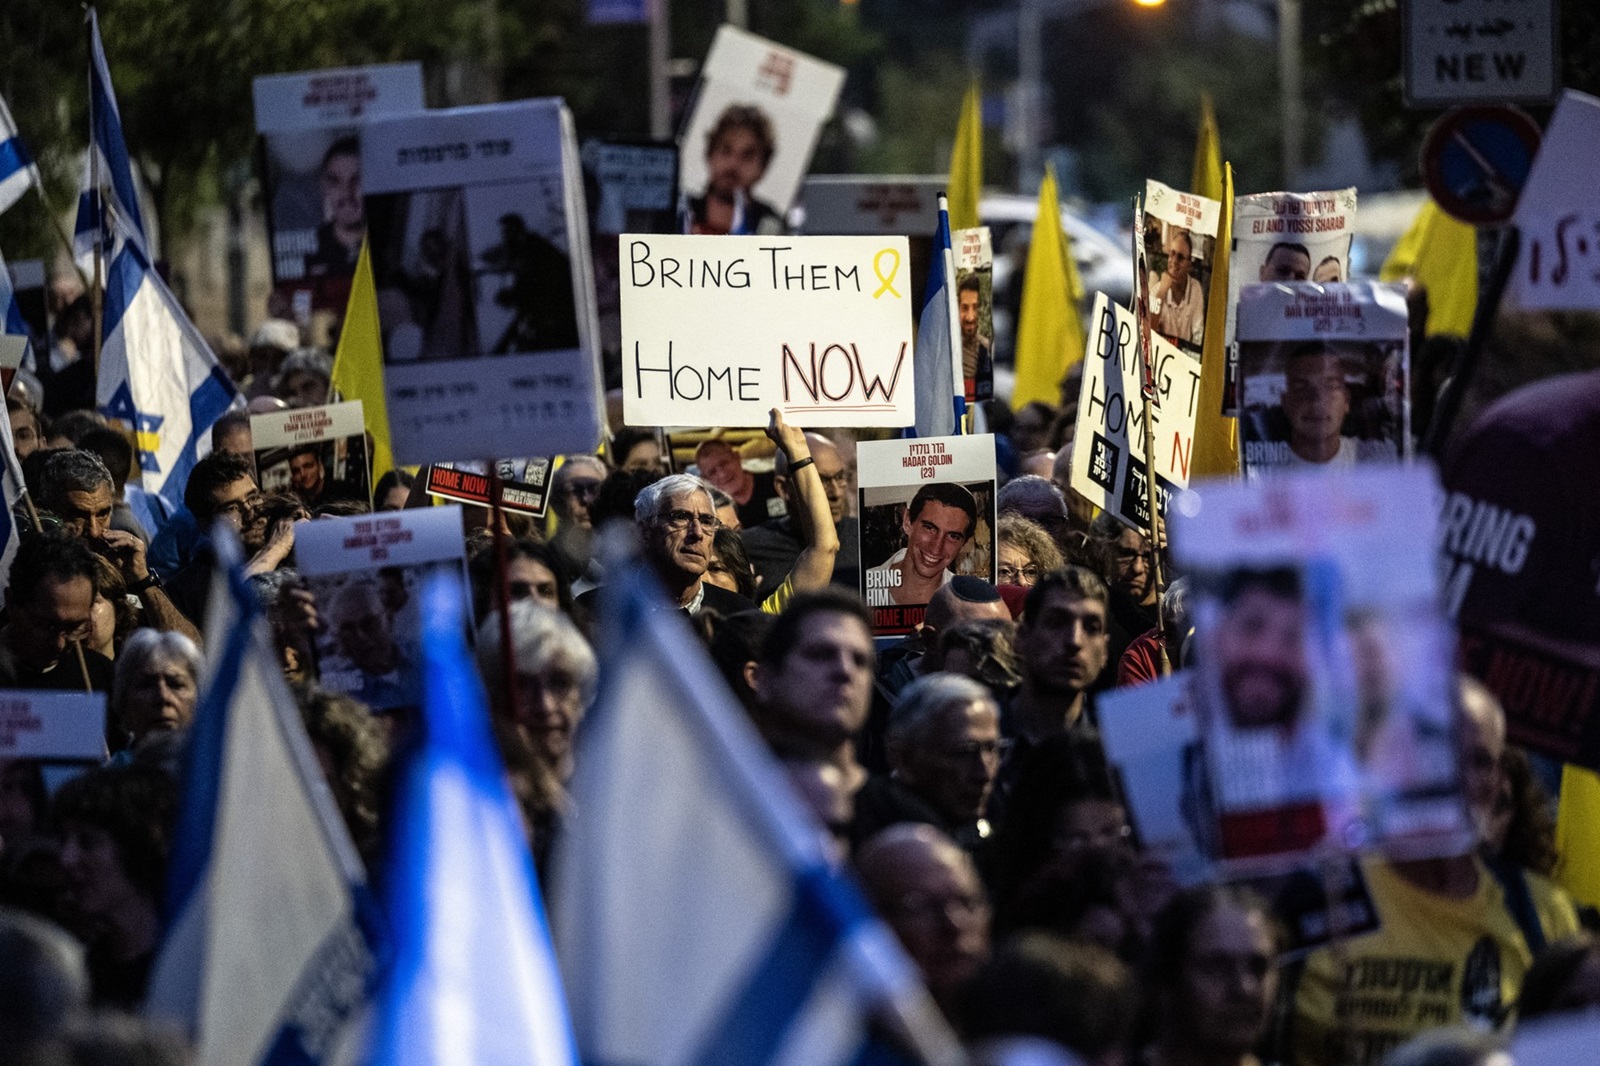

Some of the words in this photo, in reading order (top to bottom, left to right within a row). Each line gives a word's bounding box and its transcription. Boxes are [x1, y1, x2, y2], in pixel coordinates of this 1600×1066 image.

[1435, 53, 1526, 82] NEW
[1252, 220, 1265, 234] ELI
[1265, 217, 1283, 233] AND
[1286, 218, 1313, 234] YOSSI
[1315, 214, 1345, 232] SHARABI
[630, 240, 751, 288] BRING
[759, 246, 861, 292] THEM
[635, 340, 761, 400] HOME
[781, 341, 908, 404] NOW
[909, 443, 930, 457] גולדין
[931, 443, 945, 454] הדר
[902, 456, 927, 467] HADAR
[928, 454, 953, 466] GOLDIN
[432, 468, 461, 489] HOME
[920, 467, 935, 479] (23)
[1443, 491, 1537, 575] RING
[866, 569, 902, 588] BRING
[867, 588, 889, 607] HIM
[872, 608, 900, 627] OME
